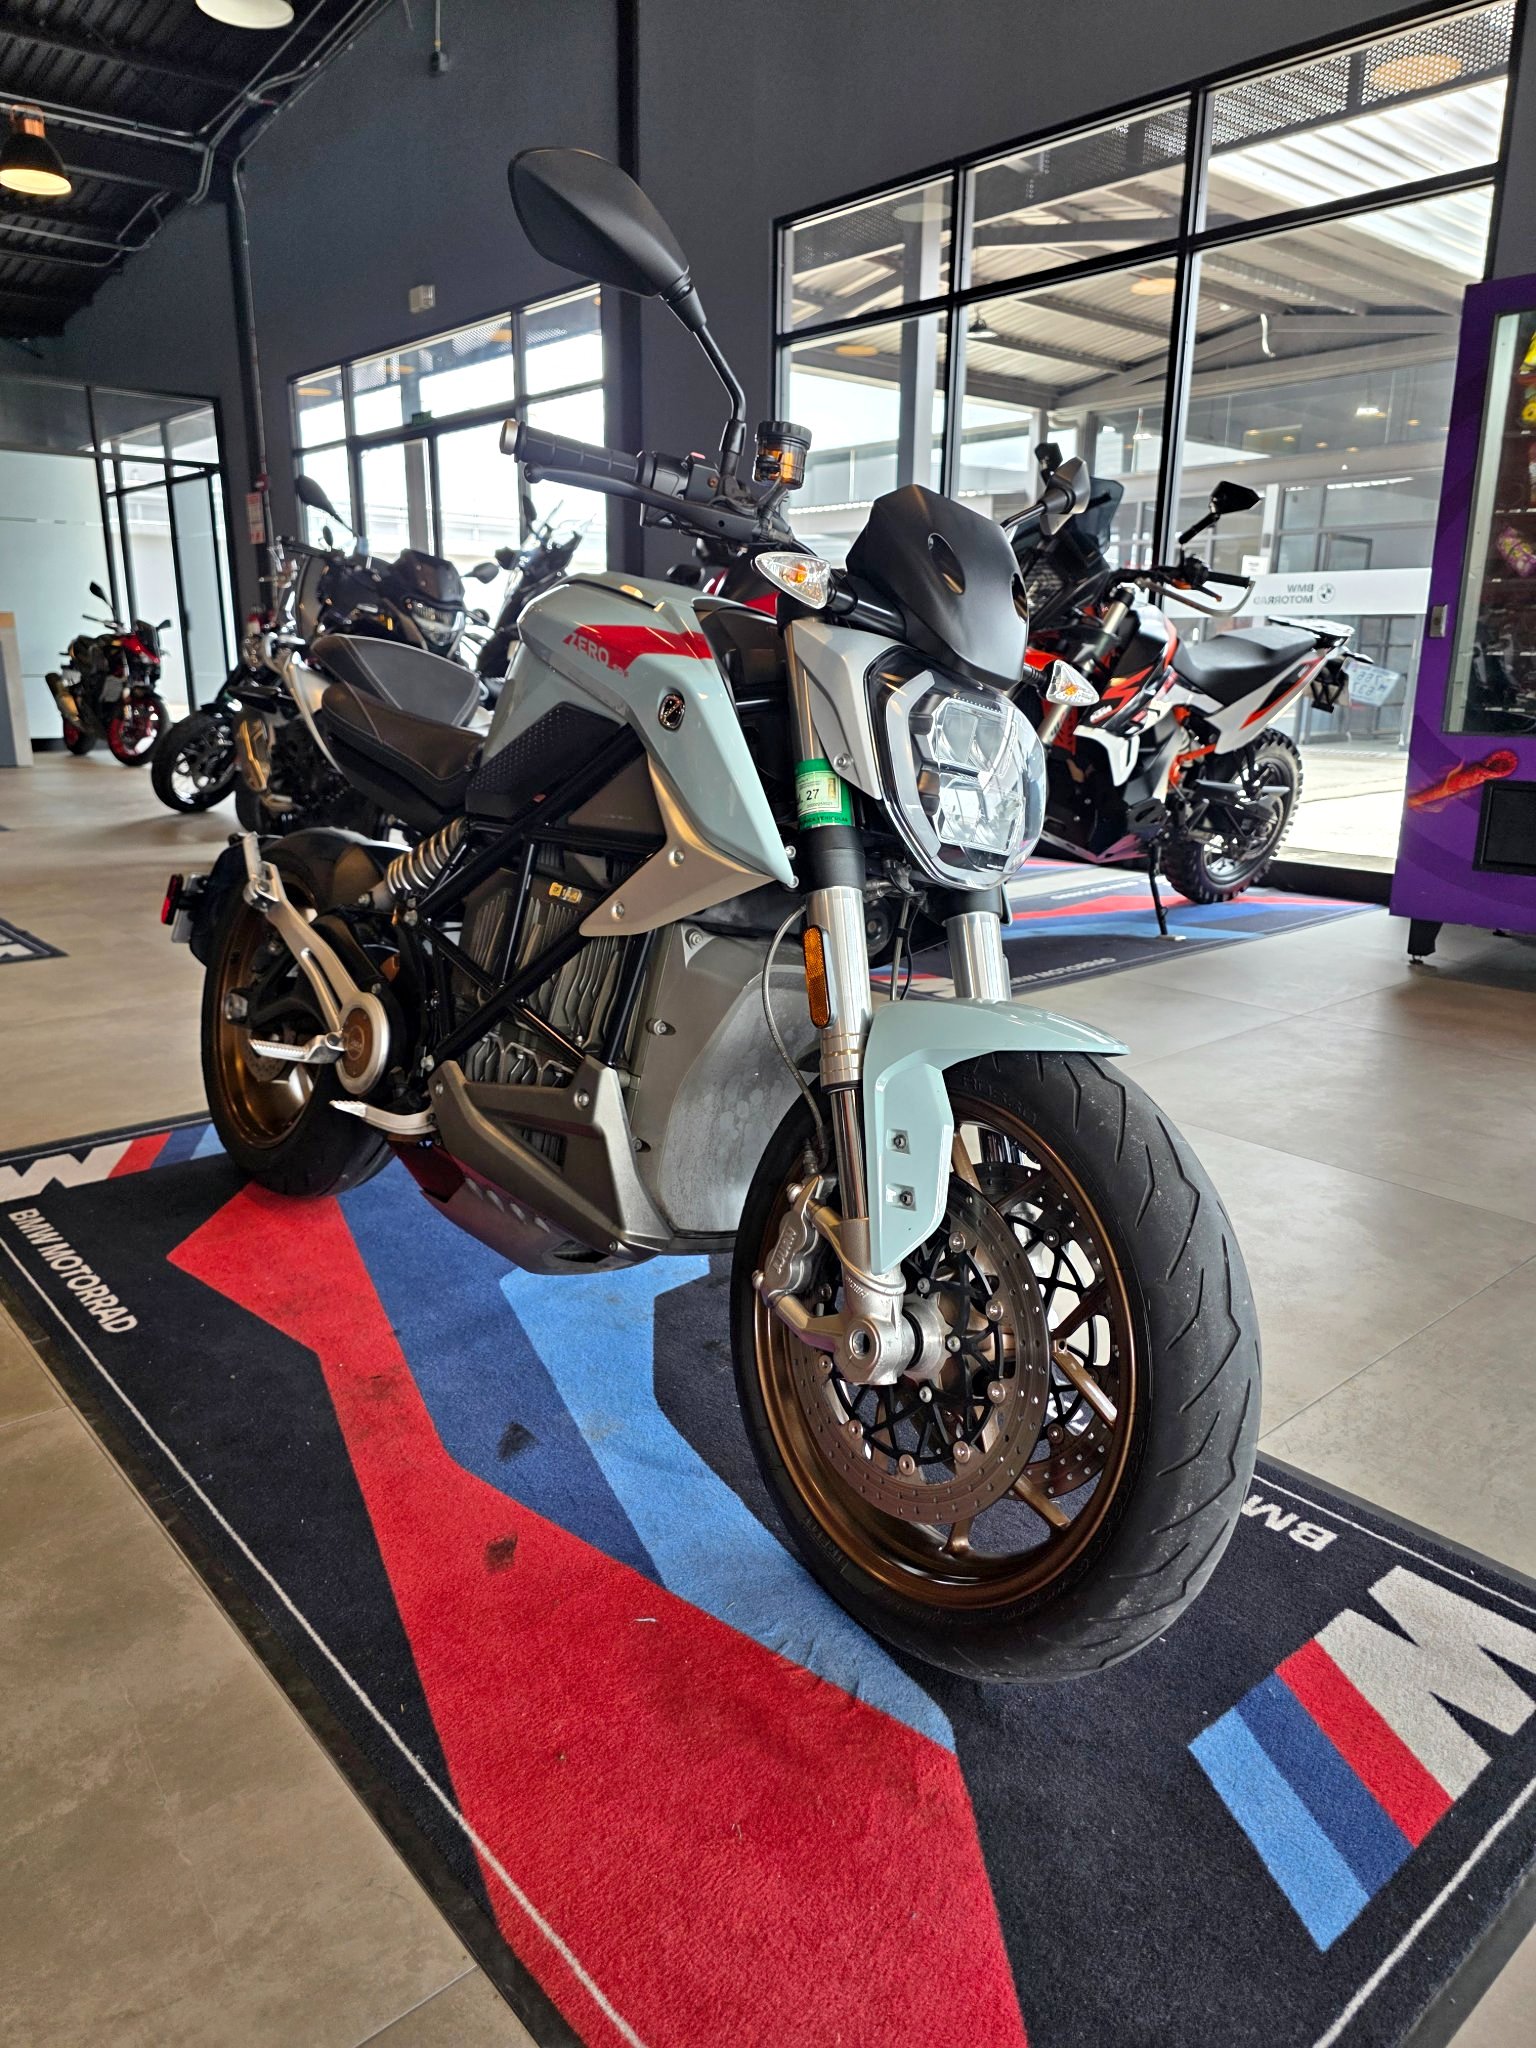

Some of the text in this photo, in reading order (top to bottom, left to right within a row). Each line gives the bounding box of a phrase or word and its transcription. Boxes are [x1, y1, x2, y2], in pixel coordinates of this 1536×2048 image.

[566, 632, 609, 667] ZERO
[806, 788, 820, 801] 27
[8, 1207, 138, 1333] BMW MOTORRAD
[1241, 1494, 1338, 1552] BM
